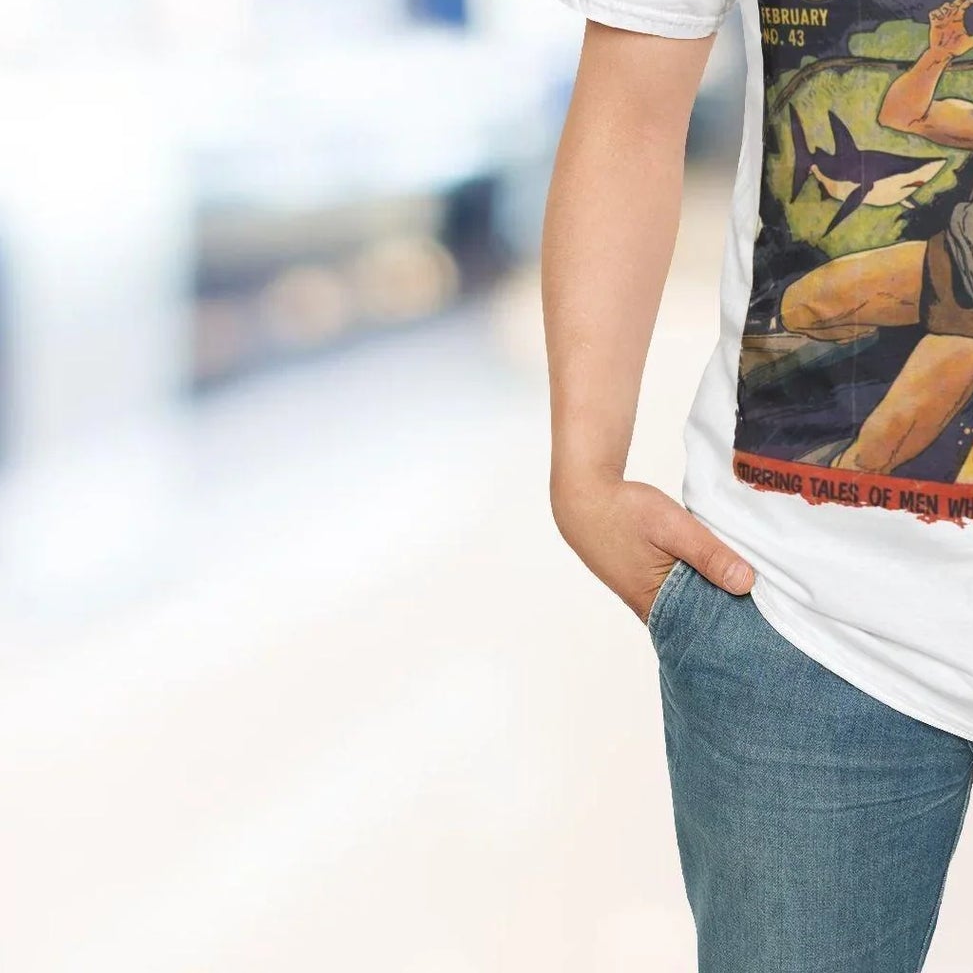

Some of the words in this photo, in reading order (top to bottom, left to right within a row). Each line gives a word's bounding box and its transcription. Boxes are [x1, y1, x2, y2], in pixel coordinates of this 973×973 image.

[788, 29, 805, 47] 43
[810, 477, 860, 504] TALES
[868, 485, 892, 509] OF
[901, 491, 939, 515] MEN
